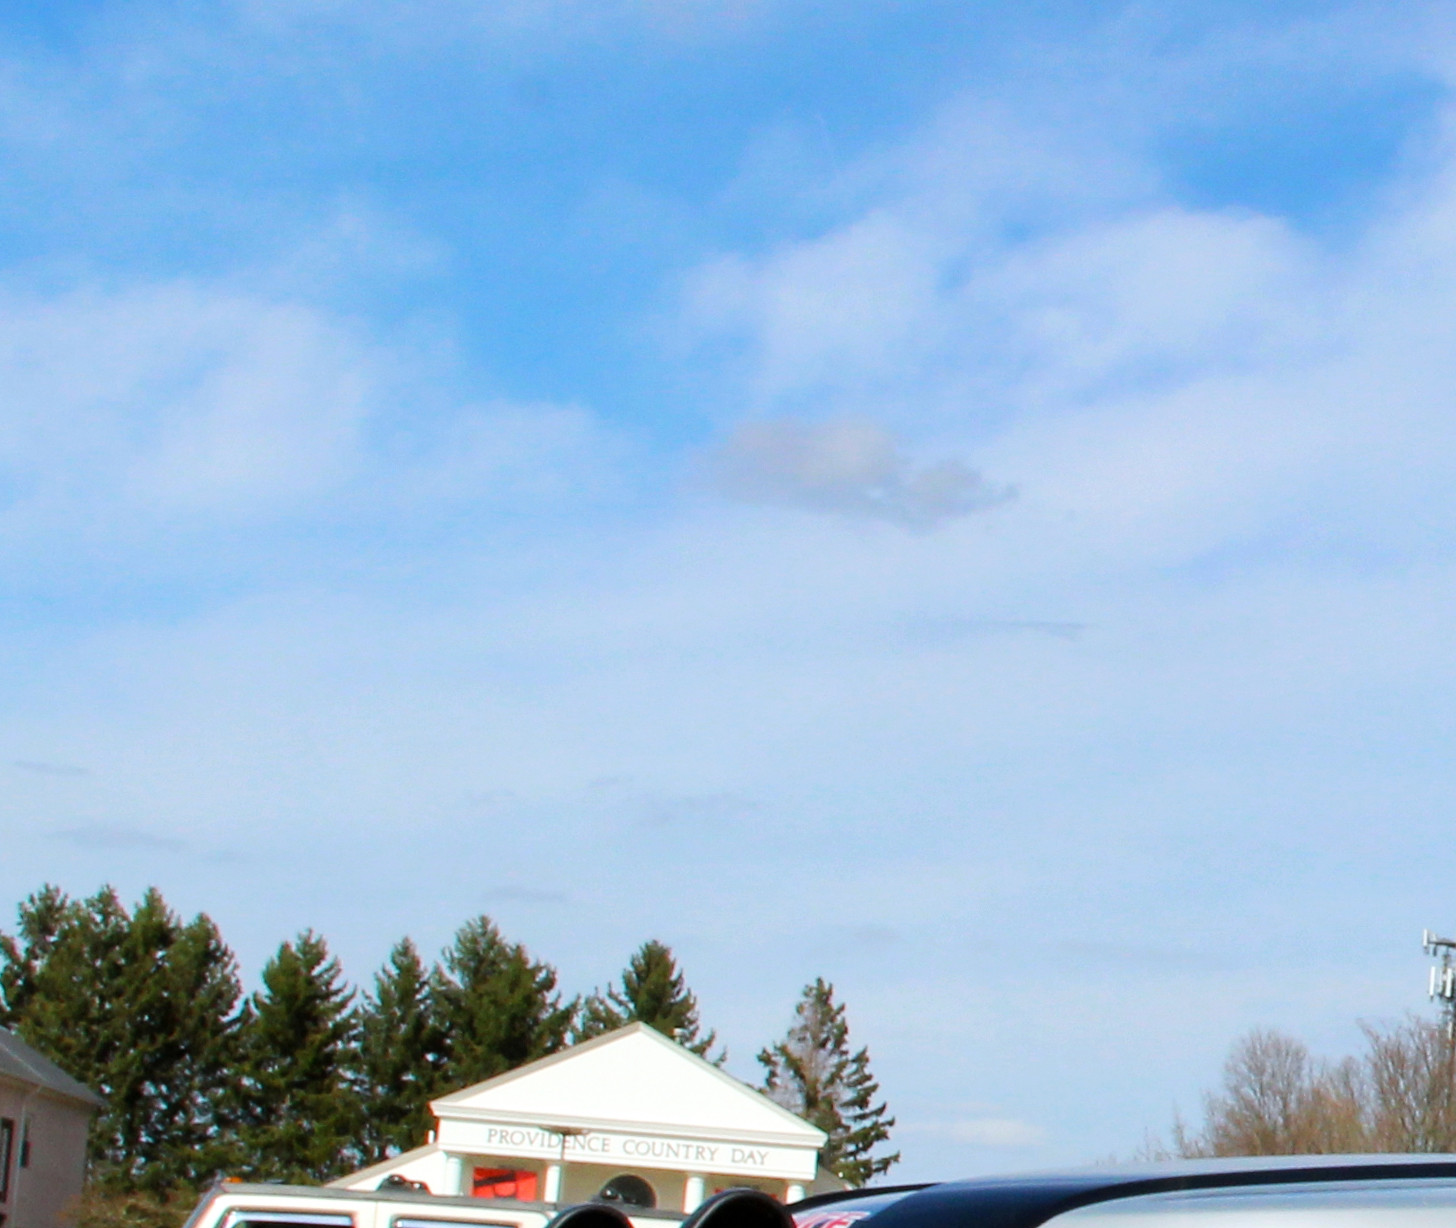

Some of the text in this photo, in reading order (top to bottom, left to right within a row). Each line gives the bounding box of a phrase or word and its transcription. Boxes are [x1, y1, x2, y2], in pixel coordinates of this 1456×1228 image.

[487, 1128, 769, 1166] PROVIDENCE COUNTRY DAY
